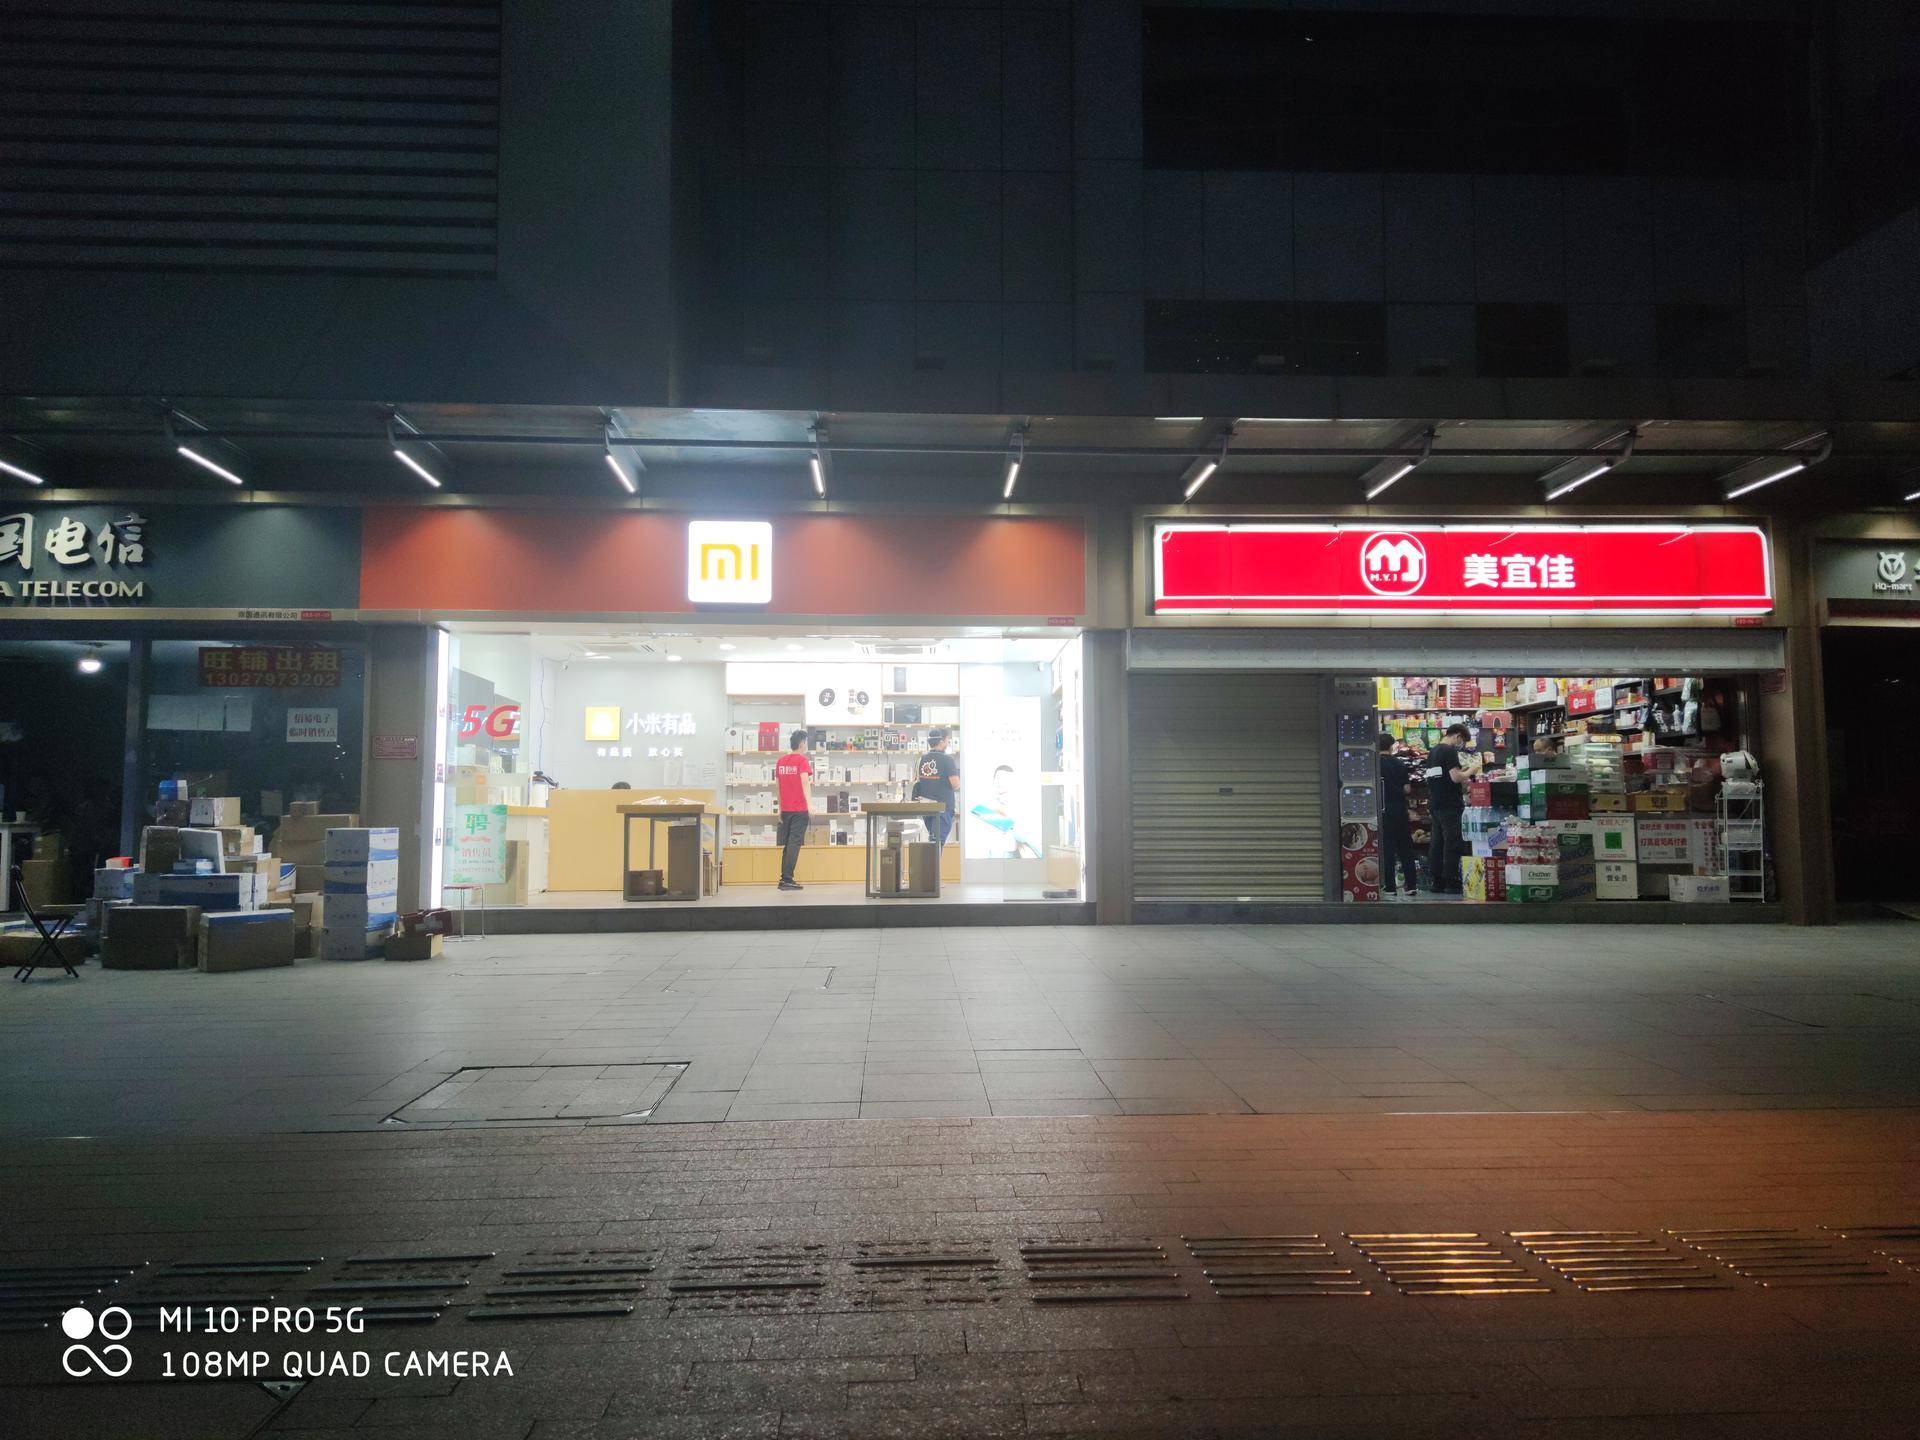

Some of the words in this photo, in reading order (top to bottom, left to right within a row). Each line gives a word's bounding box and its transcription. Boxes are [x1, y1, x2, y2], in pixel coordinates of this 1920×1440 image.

[1464, 554, 1576, 590] 美宜佳
[18, 580, 144, 597] TELECOM
[204, 651, 339, 672] 旺铺出租
[205, 672, 336, 687] 13027973202
[457, 704, 519, 737] 5G
[626, 712, 697, 736] 小米有品
[464, 813, 490, 835] 聘
